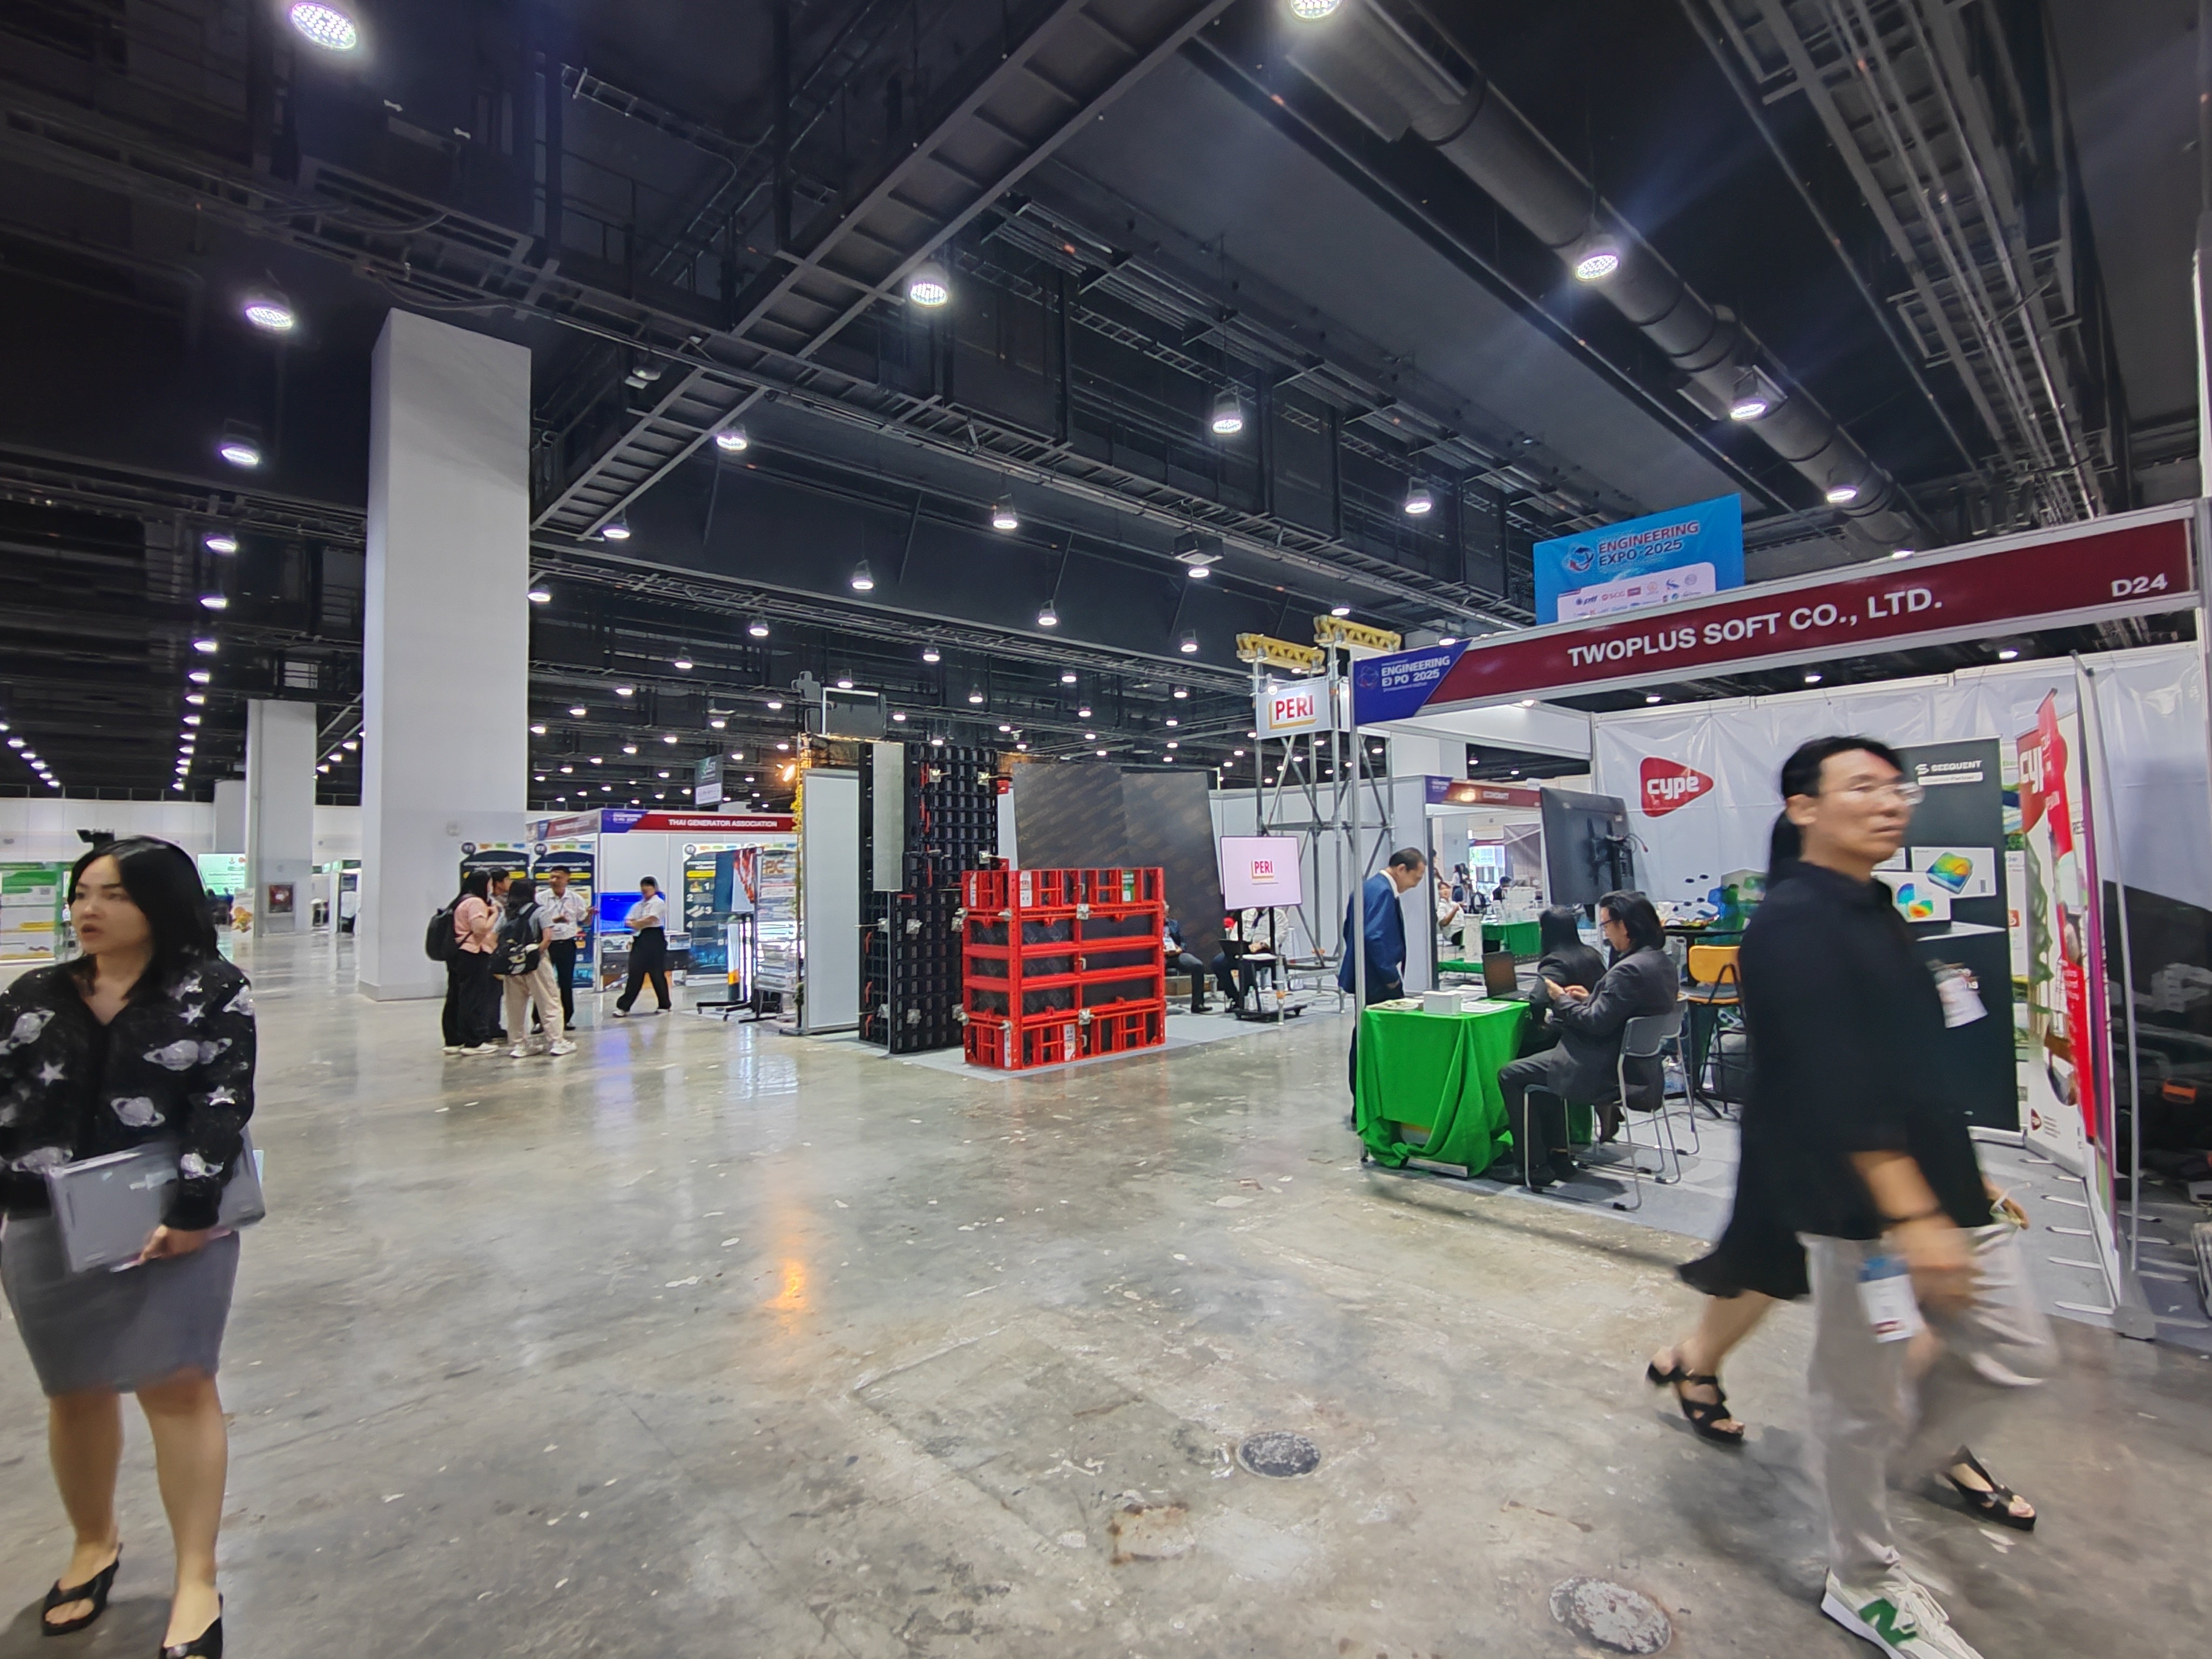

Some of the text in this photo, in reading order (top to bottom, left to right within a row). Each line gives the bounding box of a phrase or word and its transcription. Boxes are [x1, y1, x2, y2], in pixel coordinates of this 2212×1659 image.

[1599, 521, 1700, 553] ENGINEERING
[1599, 550, 1637, 567] EXPO
[1645, 539, 1683, 555] 2025
[2111, 573, 2168, 597] D24
[1568, 588, 1943, 667] TWOPLUS SOFT CO., LTD.
[1381, 656, 1451, 677] ENGINEERING
[1413, 668, 1440, 682] 2025
[1276, 694, 1314, 720] PERI
[1647, 776, 1700, 800] cype
[1254, 860, 1273, 874] PERI
[704, 882, 710, 891] 1
[686, 894, 693, 902] 2
[705, 906, 712, 915] 3
[686, 921, 693, 929] 4
